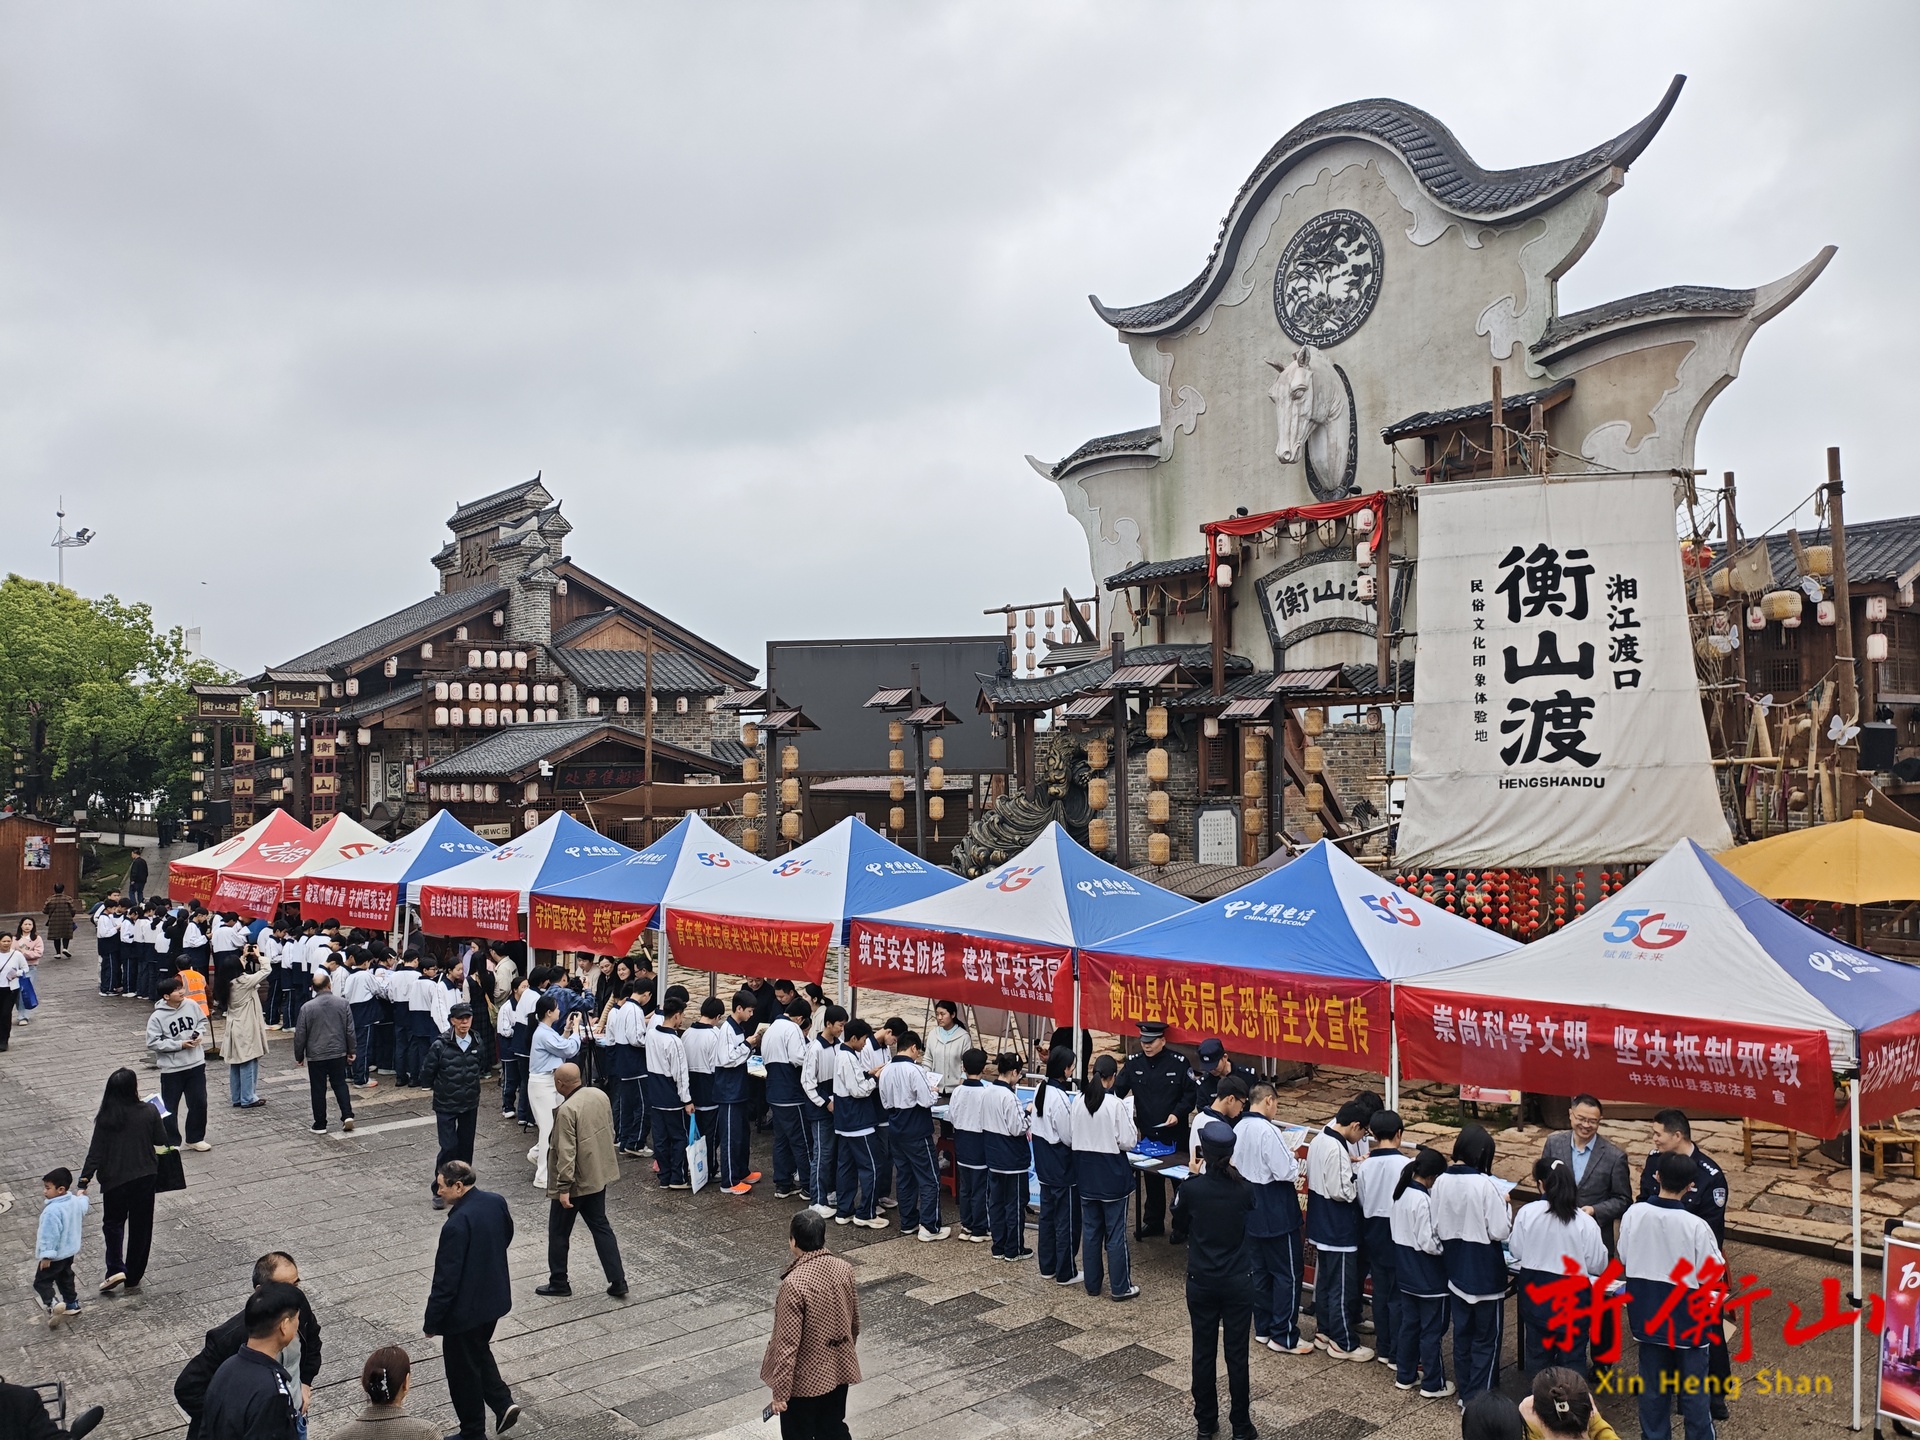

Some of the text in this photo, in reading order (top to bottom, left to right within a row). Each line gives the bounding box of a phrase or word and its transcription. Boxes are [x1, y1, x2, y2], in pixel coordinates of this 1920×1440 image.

[1606, 574, 1643, 690] 湘江渡口
[1470, 579, 1488, 742] 民俗文化印象体验地
[1495, 543, 1601, 768] 衡山渡
[202, 702, 238, 712] 衡山渡
[278, 690, 317, 702] 衡山渡
[1499, 777, 1606, 790] HENGSHANDU
[697, 852, 731, 868] 5G
[772, 860, 803, 877] 5G
[986, 866, 1032, 892] 5G
[1093, 878, 1135, 892] 中国电信
[349, 887, 392, 911] 守护国家安全
[1251, 901, 1317, 922] 中国电信
[1359, 890, 1420, 927] 5G
[535, 903, 587, 933] 守护国家安全
[1244, 914, 1306, 927] CHINA TELECOM
[1603, 909, 1687, 949] 5G
[858, 930, 1061, 992] 筑牢安全防线 建设平安家园
[1109, 969, 1369, 1055] 衡山县公安局反恐怖主义宣传
[169, 1016, 194, 1037] GAP
[1432, 1004, 1802, 1088] 崇尚科学文明 坚决抵制邪教
[1628, 1071, 1757, 1100] 中共衡山县委政法委
